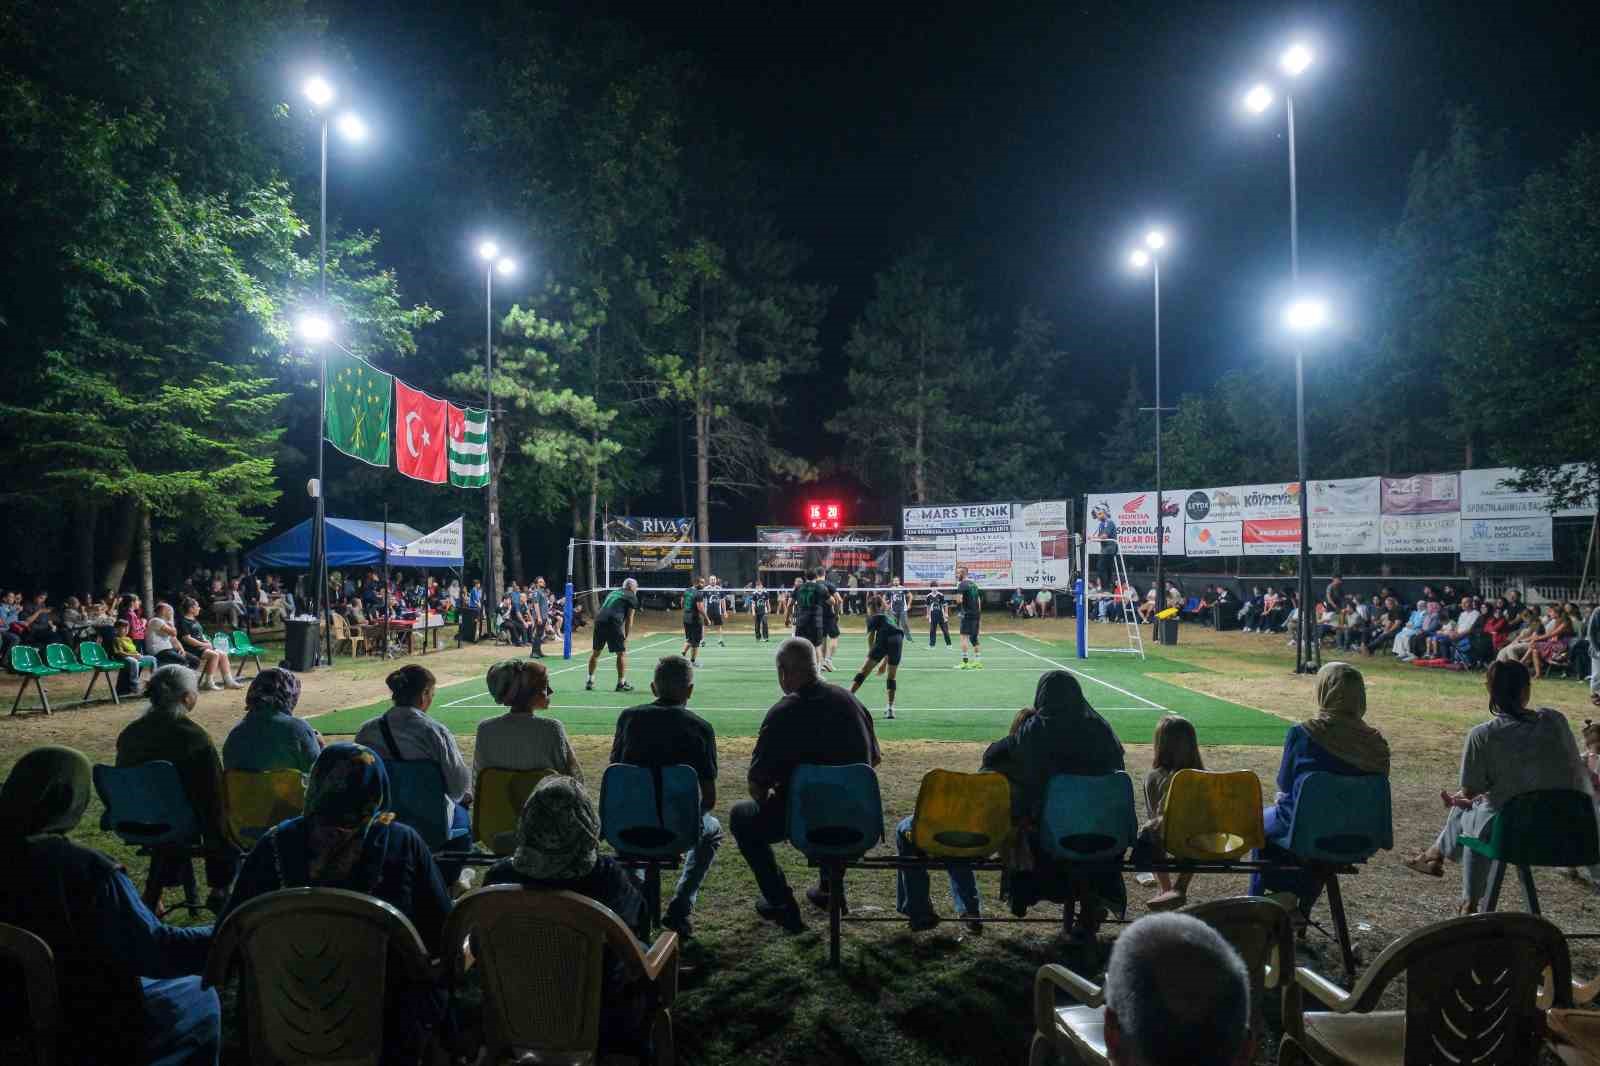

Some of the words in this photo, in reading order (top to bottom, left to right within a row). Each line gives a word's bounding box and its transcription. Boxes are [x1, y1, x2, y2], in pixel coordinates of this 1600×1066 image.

[921, 508, 958, 520] MARS
[1116, 526, 1171, 534] SPORCULAA
[1042, 574, 1057, 584] vip
